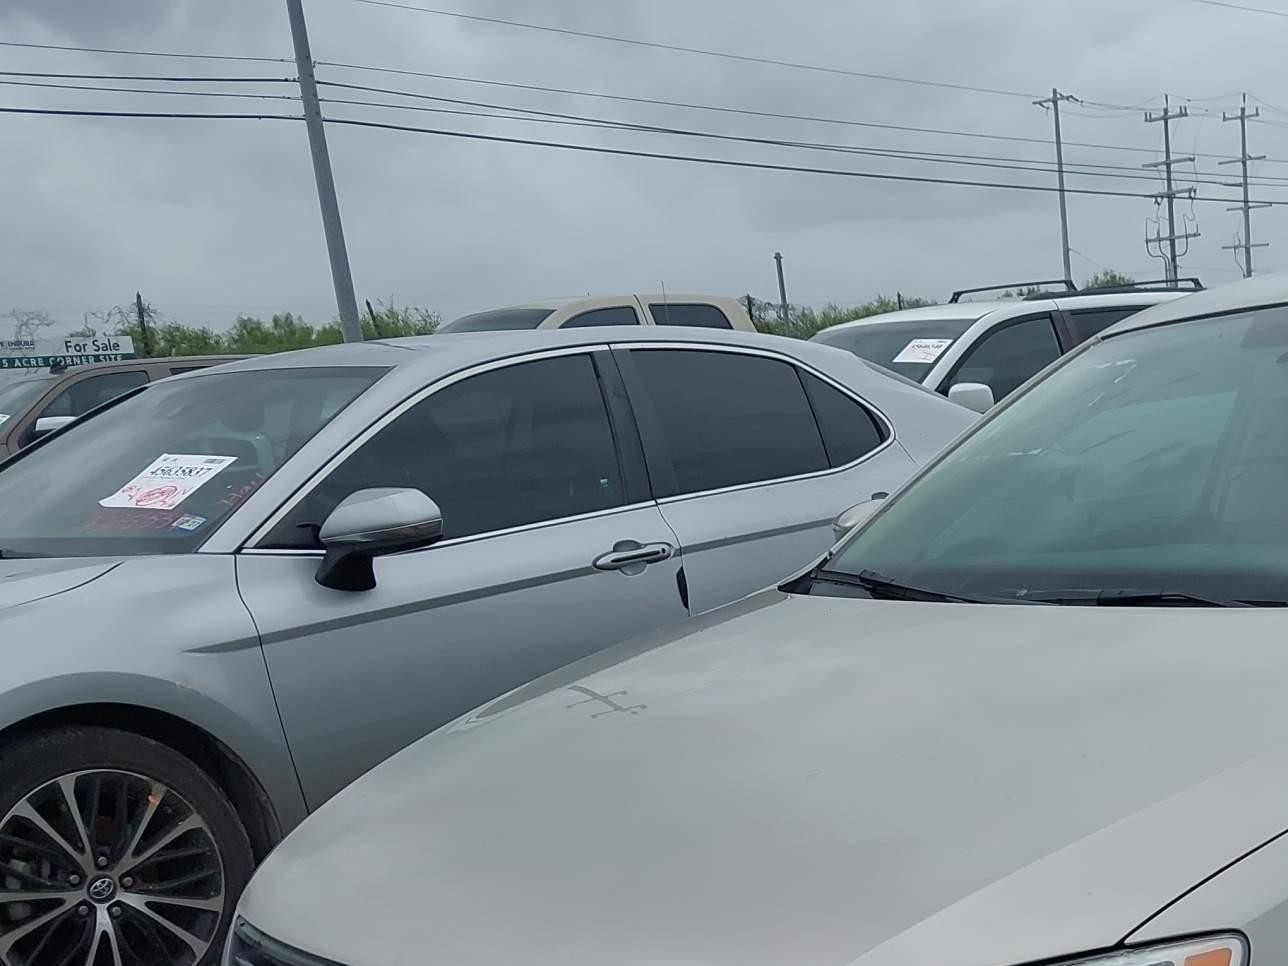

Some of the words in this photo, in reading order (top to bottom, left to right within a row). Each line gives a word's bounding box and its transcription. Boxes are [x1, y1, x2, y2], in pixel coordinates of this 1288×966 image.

[64, 340, 88, 353] For
[92, 338, 120, 352] Sale
[14, 358, 45, 367] ACRE
[49, 355, 95, 366] CORNER
[99, 354, 123, 363] SITE
